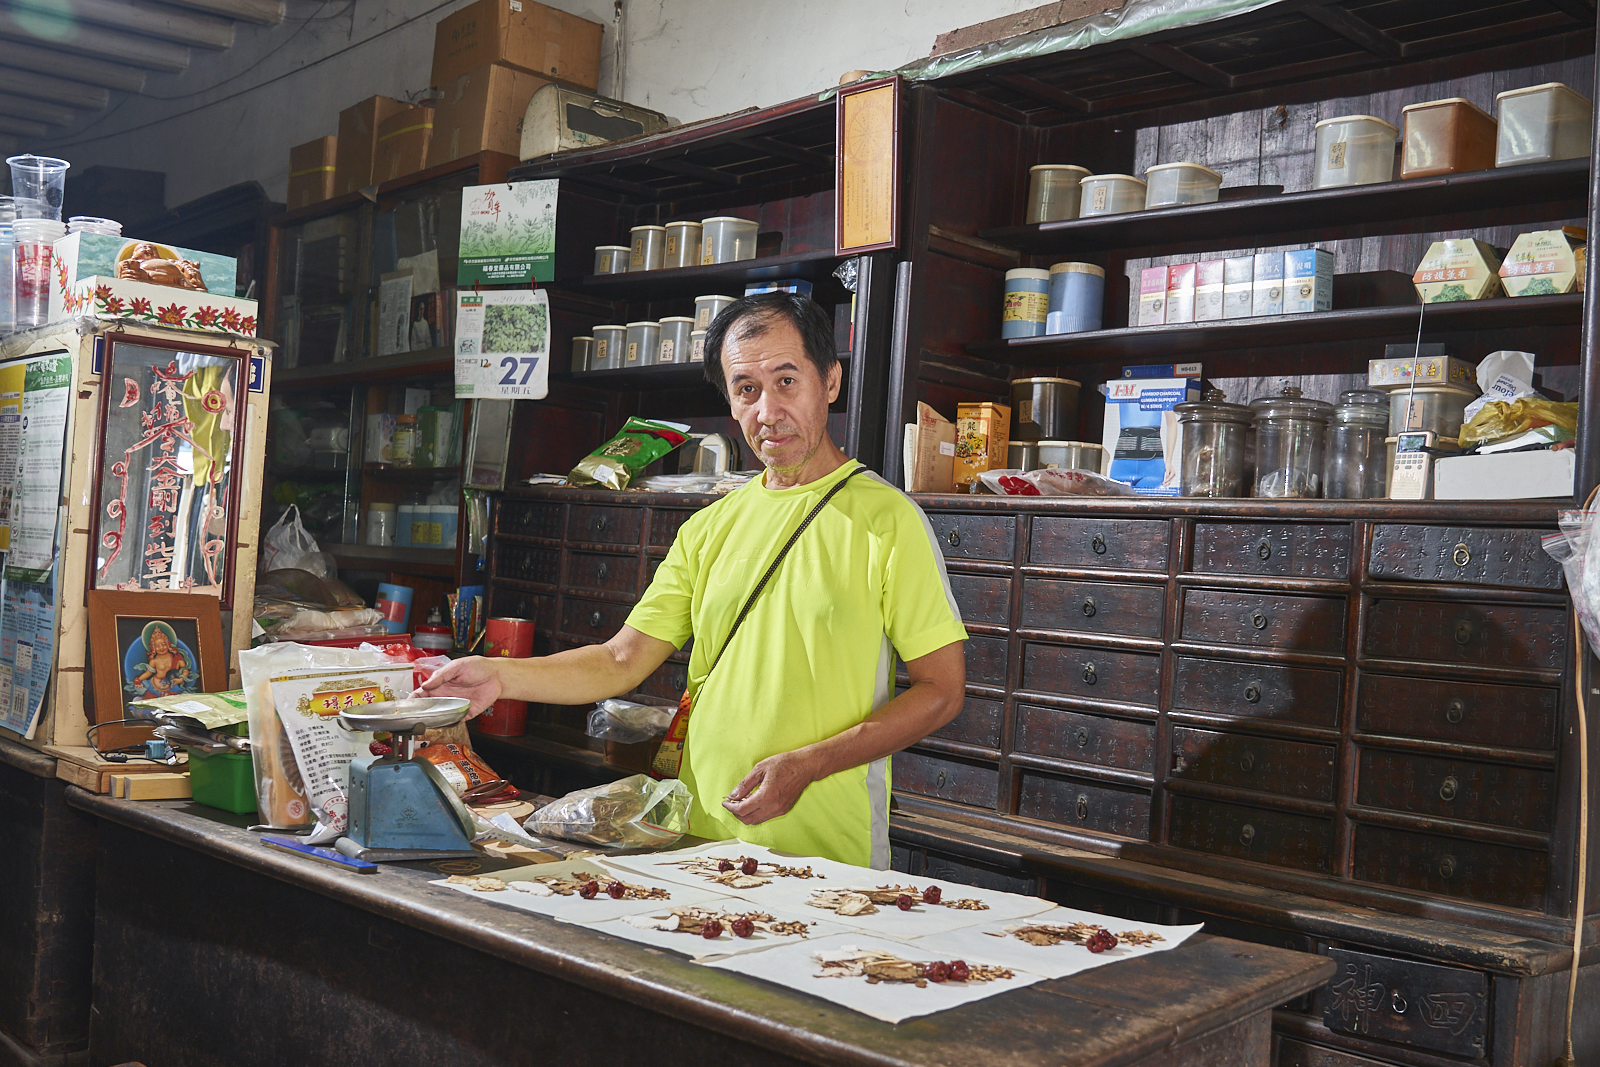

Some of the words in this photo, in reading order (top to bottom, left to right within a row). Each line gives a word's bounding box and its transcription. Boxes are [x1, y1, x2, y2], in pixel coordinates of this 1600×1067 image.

[480, 358, 490, 368] 12
[498, 356, 540, 386] 27
[500, 386, 531, 395] 星期五
[1492, 384, 1515, 397] efour
[1332, 963, 1386, 1034] 神
